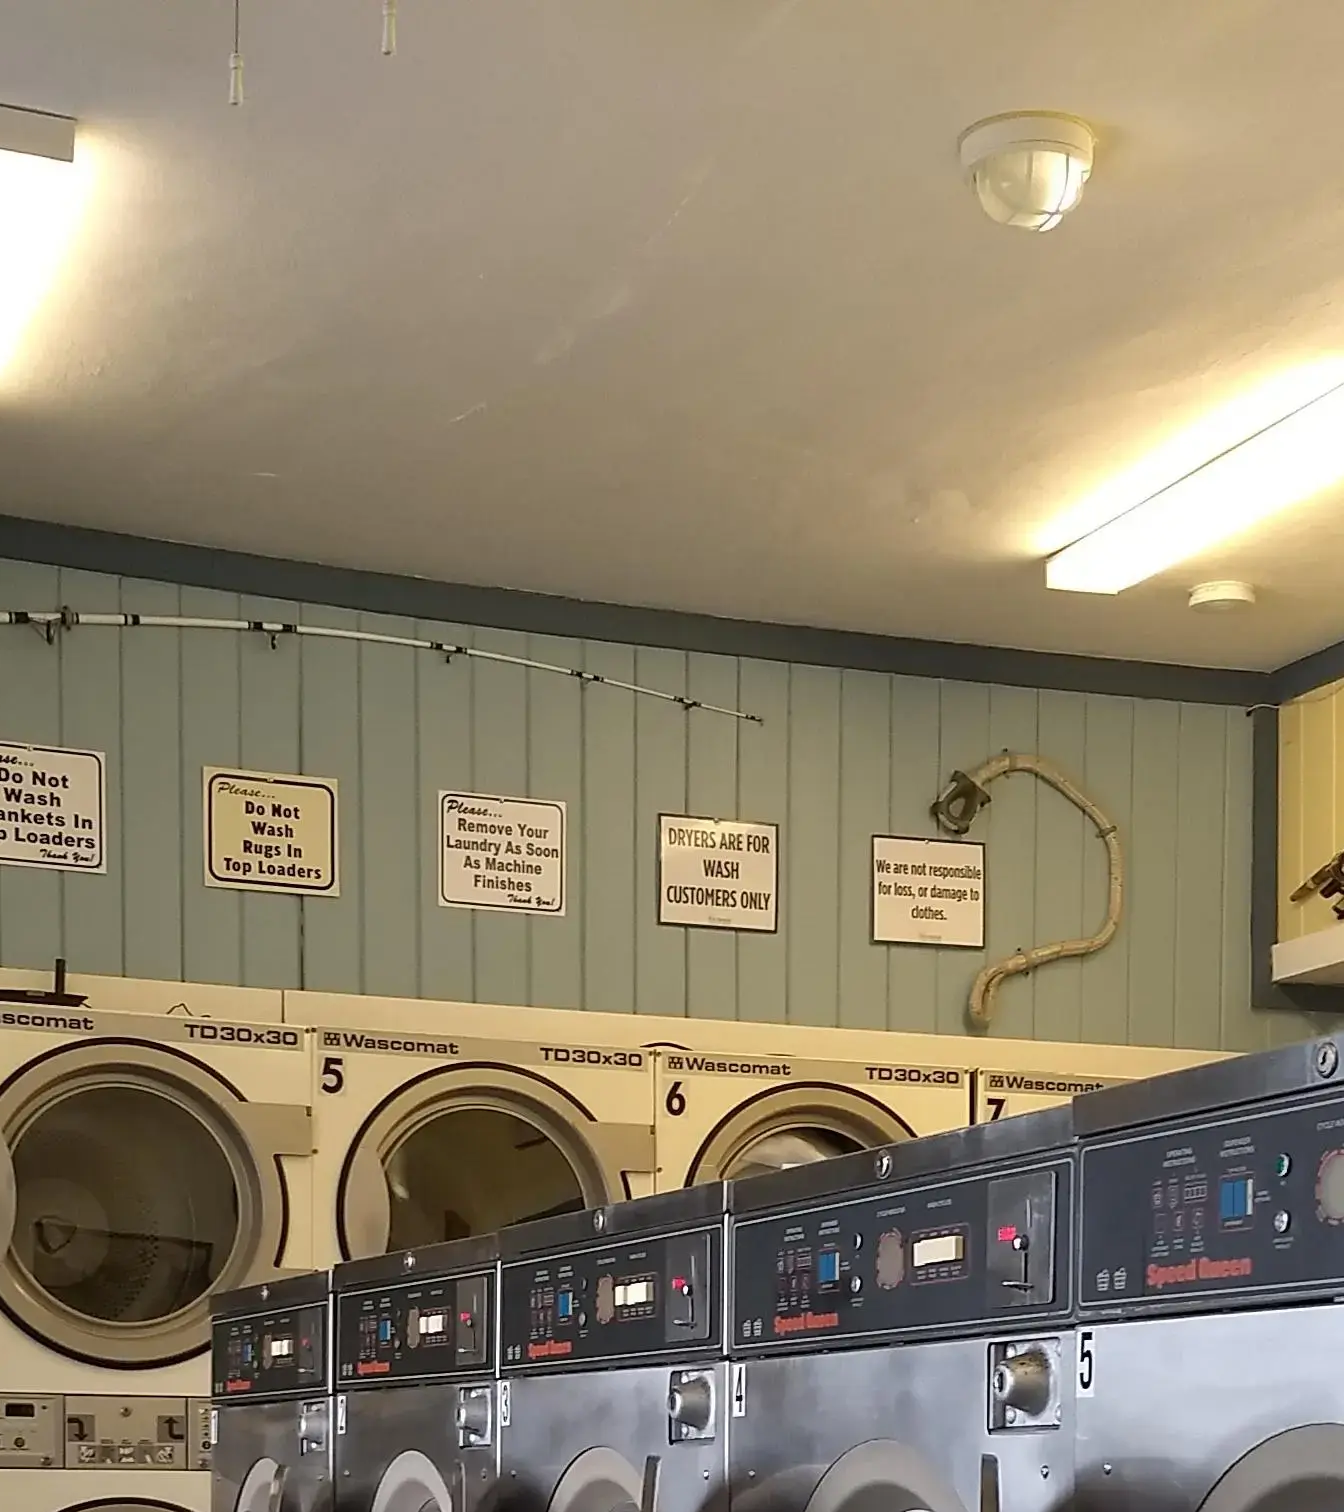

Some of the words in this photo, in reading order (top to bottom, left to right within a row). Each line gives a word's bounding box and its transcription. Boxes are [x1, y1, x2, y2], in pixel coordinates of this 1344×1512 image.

[32, 771, 69, 789] Not
[4, 787, 61, 807] Wash
[217, 782, 275, 799] Please...
[245, 801, 265, 815] Do
[272, 804, 300, 819] Not
[447, 800, 502, 817] Please...
[74, 814, 93, 830] In
[251, 821, 293, 838] Wash
[458, 818, 513, 836] Remove
[517, 824, 549, 839] Your
[14, 827, 95, 849] Loaders
[446, 835, 501, 856] Laundry
[505, 841, 522, 855] As
[526, 843, 559, 858] Soon
[668, 827, 716, 849] DRYERS
[719, 833, 743, 851] ARE
[747, 835, 770, 854] FOR
[39, 849, 68, 859] Thank
[72, 852, 95, 863] You!
[243, 840, 281, 858] Rugs
[287, 844, 302, 858] In
[224, 858, 251, 876] Top
[258, 861, 321, 879] Loaders
[463, 856, 481, 869] As
[485, 857, 542, 875] Machine
[703, 859, 739, 879] WASH
[876, 860, 891, 873] We
[893, 863, 908, 874] are
[911, 863, 926, 876] not
[929, 865, 981, 880] responsible
[474, 875, 532, 892] Finishes
[878, 881, 892, 895] for
[894, 882, 916, 899] loss,
[918, 886, 928, 898] or
[930, 885, 967, 902] damage
[970, 888, 979, 901] to
[507, 894, 532, 904] Thank
[667, 885, 737, 908] CUSTOMERS
[741, 891, 771, 911] ONLY
[911, 905, 947, 920] clothes.
[184, 1023, 298, 1047] TD30x30
[342, 1032, 459, 1055] Wascomat
[540, 1047, 642, 1067] TD30x30
[685, 1057, 791, 1076] Wascomat
[321, 1056, 344, 1093] 5
[865, 1066, 959, 1084] TD30x30
[1005, 1075, 1104, 1092] Wascomat
[665, 1081, 686, 1116] 6
[987, 1098, 1006, 1121] 7
[1147, 1258, 1197, 1289] Speed
[1198, 1257, 1252, 1279] Queen
[1080, 1332, 1093, 1389] 5
[736, 1367, 743, 1412] 4
